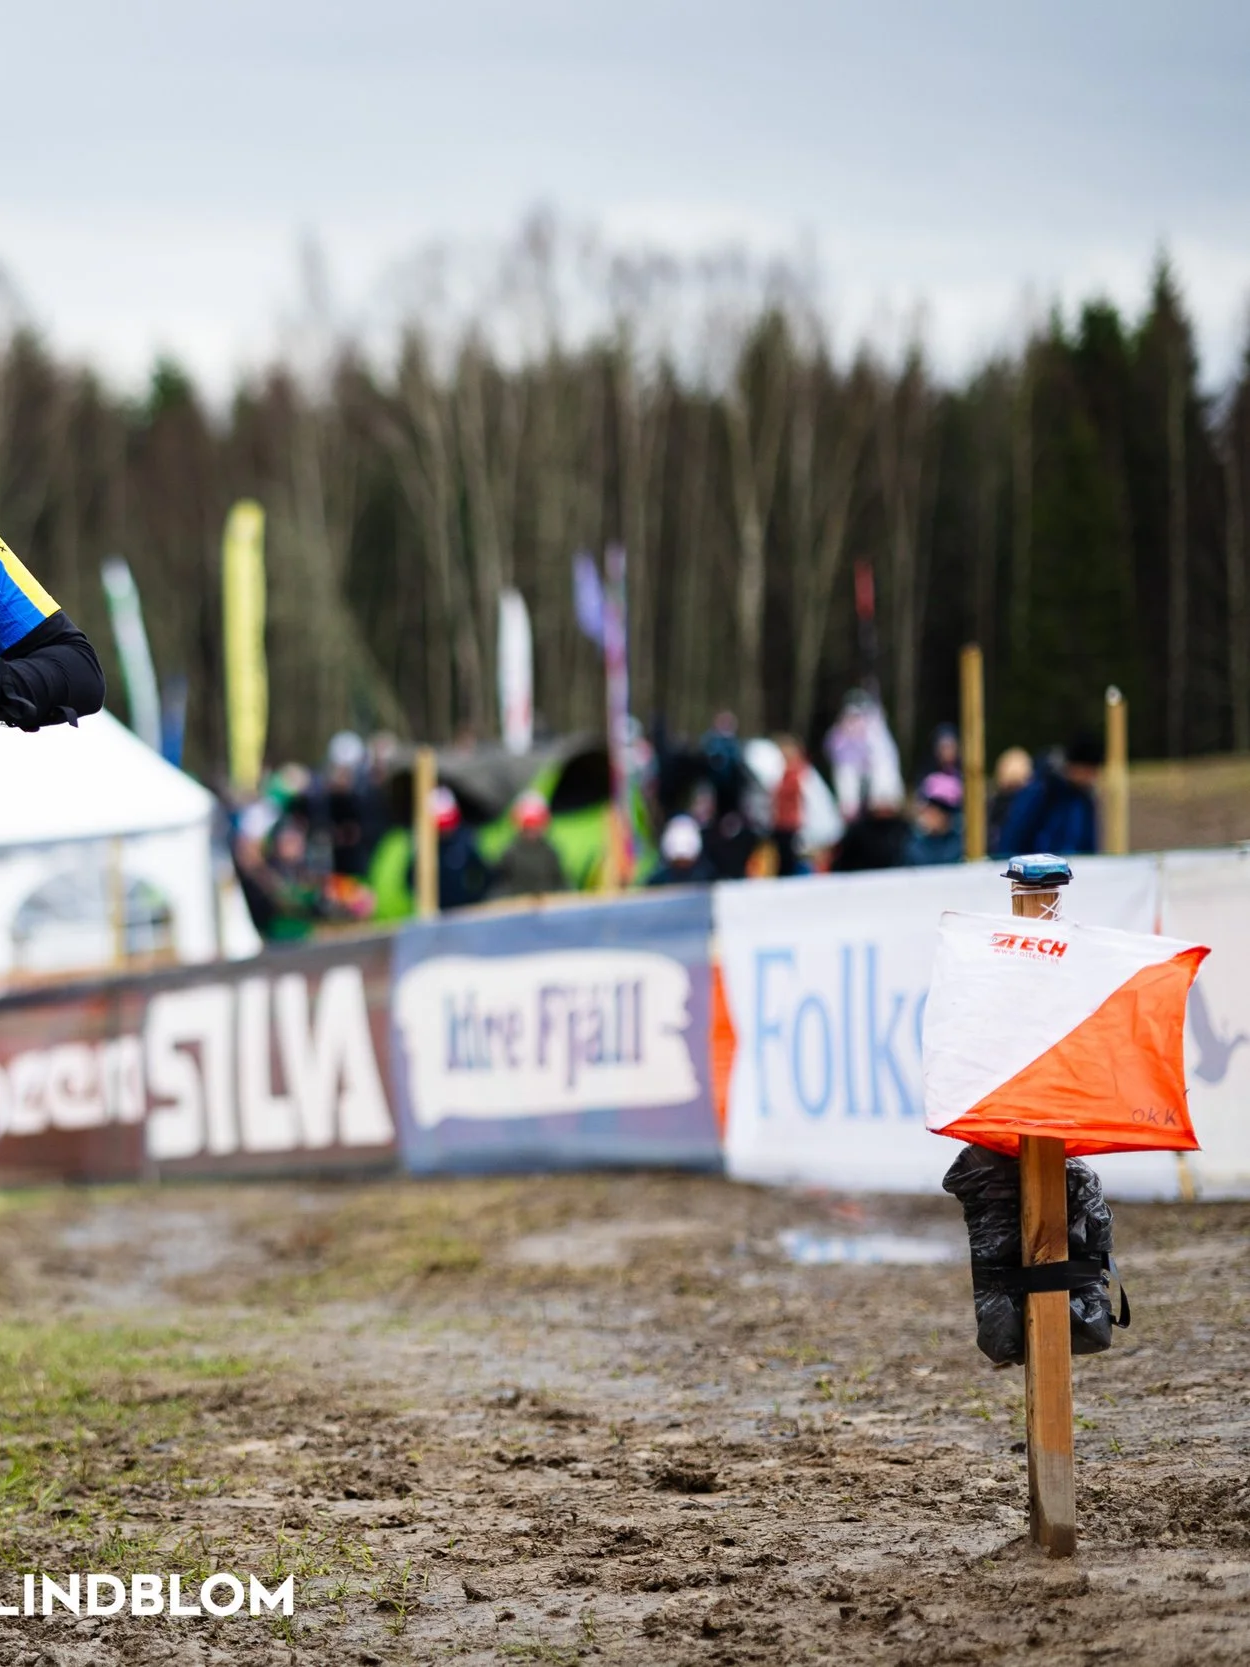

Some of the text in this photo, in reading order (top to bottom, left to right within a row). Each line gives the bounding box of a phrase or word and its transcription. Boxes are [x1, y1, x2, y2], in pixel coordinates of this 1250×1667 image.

[145, 966, 395, 1161] SILVA
[446, 978, 644, 1093] Idre Fjäll
[755, 943, 924, 1119] Folk
